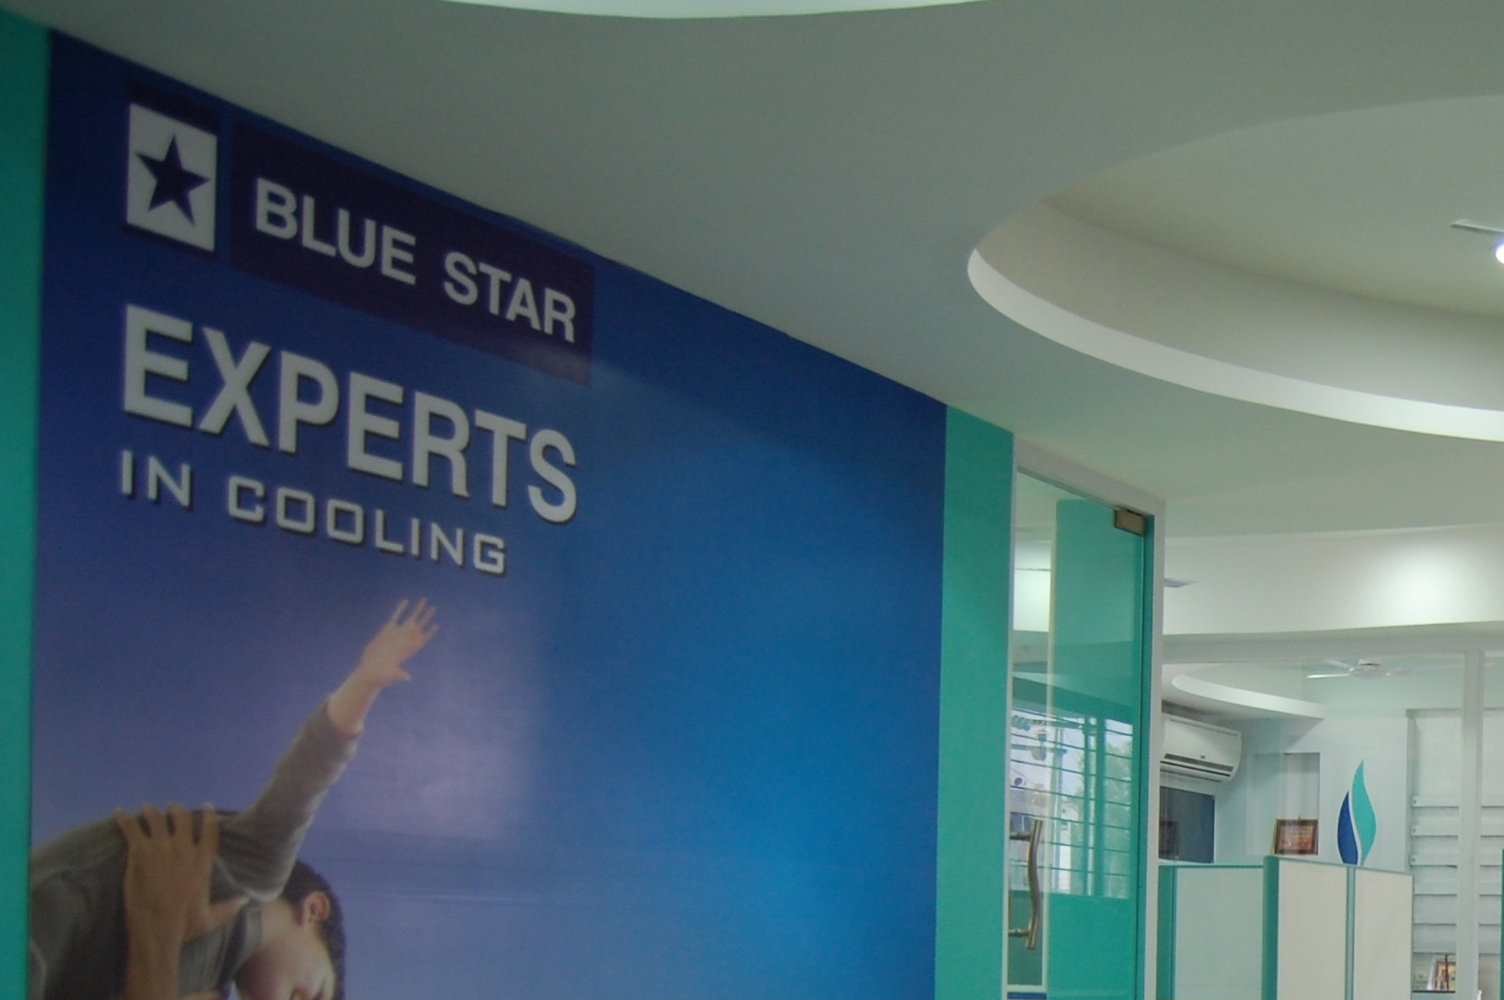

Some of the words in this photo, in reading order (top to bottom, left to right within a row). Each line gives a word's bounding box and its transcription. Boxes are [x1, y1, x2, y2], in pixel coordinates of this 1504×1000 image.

[256, 178, 416, 285] BLUE
[443, 251, 576, 342] STAR
[124, 304, 578, 523] EXPERTS
[120, 449, 191, 507] IN
[228, 476, 506, 575] COOLING
